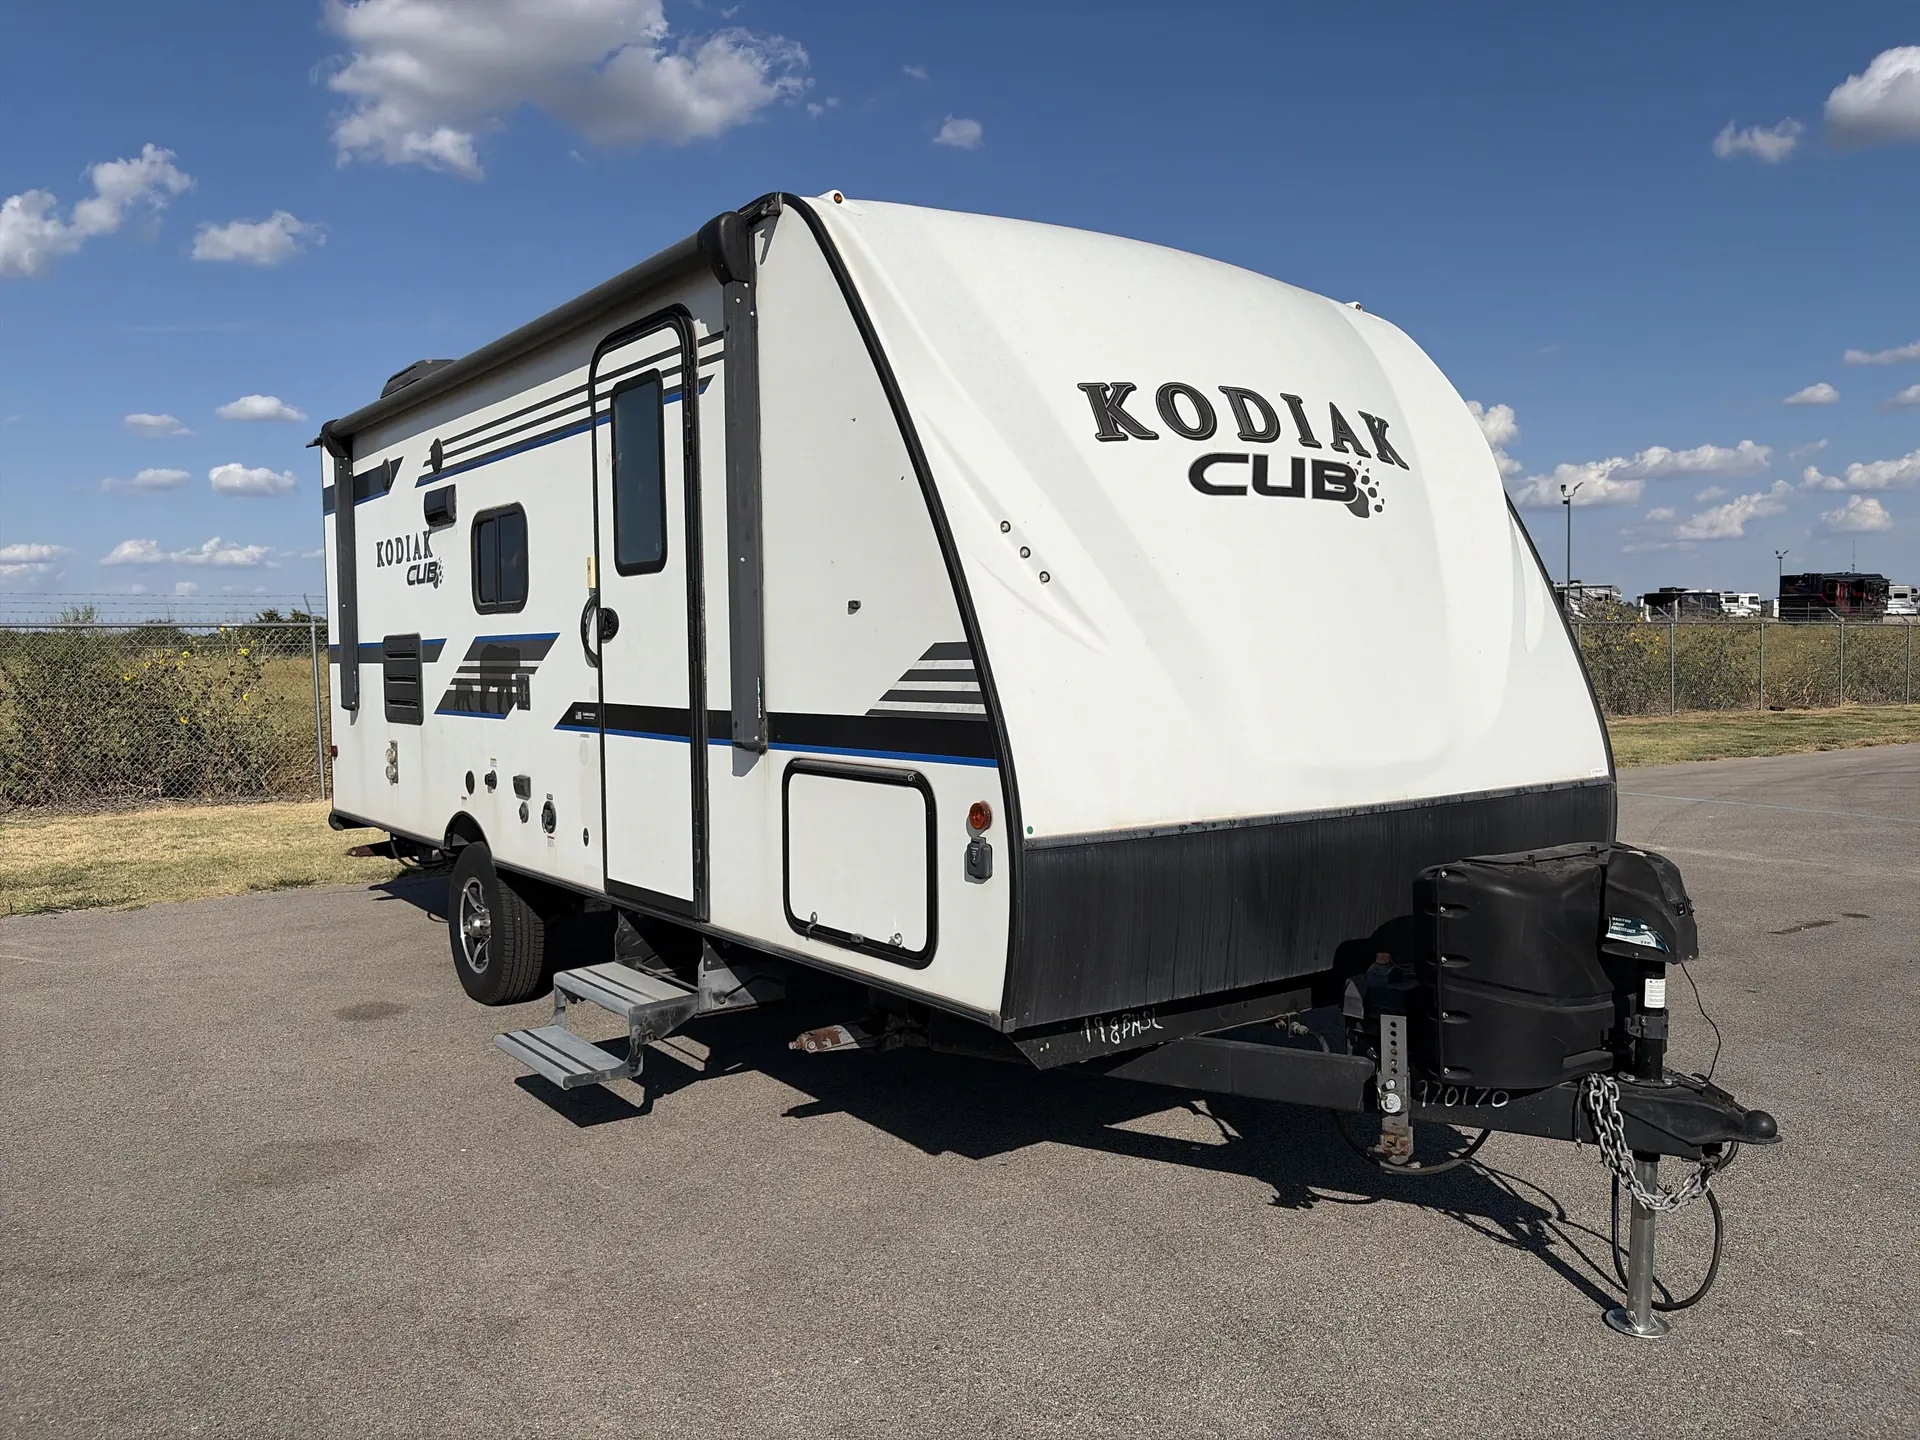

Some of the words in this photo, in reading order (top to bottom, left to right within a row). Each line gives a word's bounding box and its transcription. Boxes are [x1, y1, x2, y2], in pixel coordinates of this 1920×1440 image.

[1077, 381, 1411, 471] KODIAK
[1187, 451, 1359, 504] CUB
[375, 529, 434, 568] KODIAK
[406, 560, 440, 587] CUB
